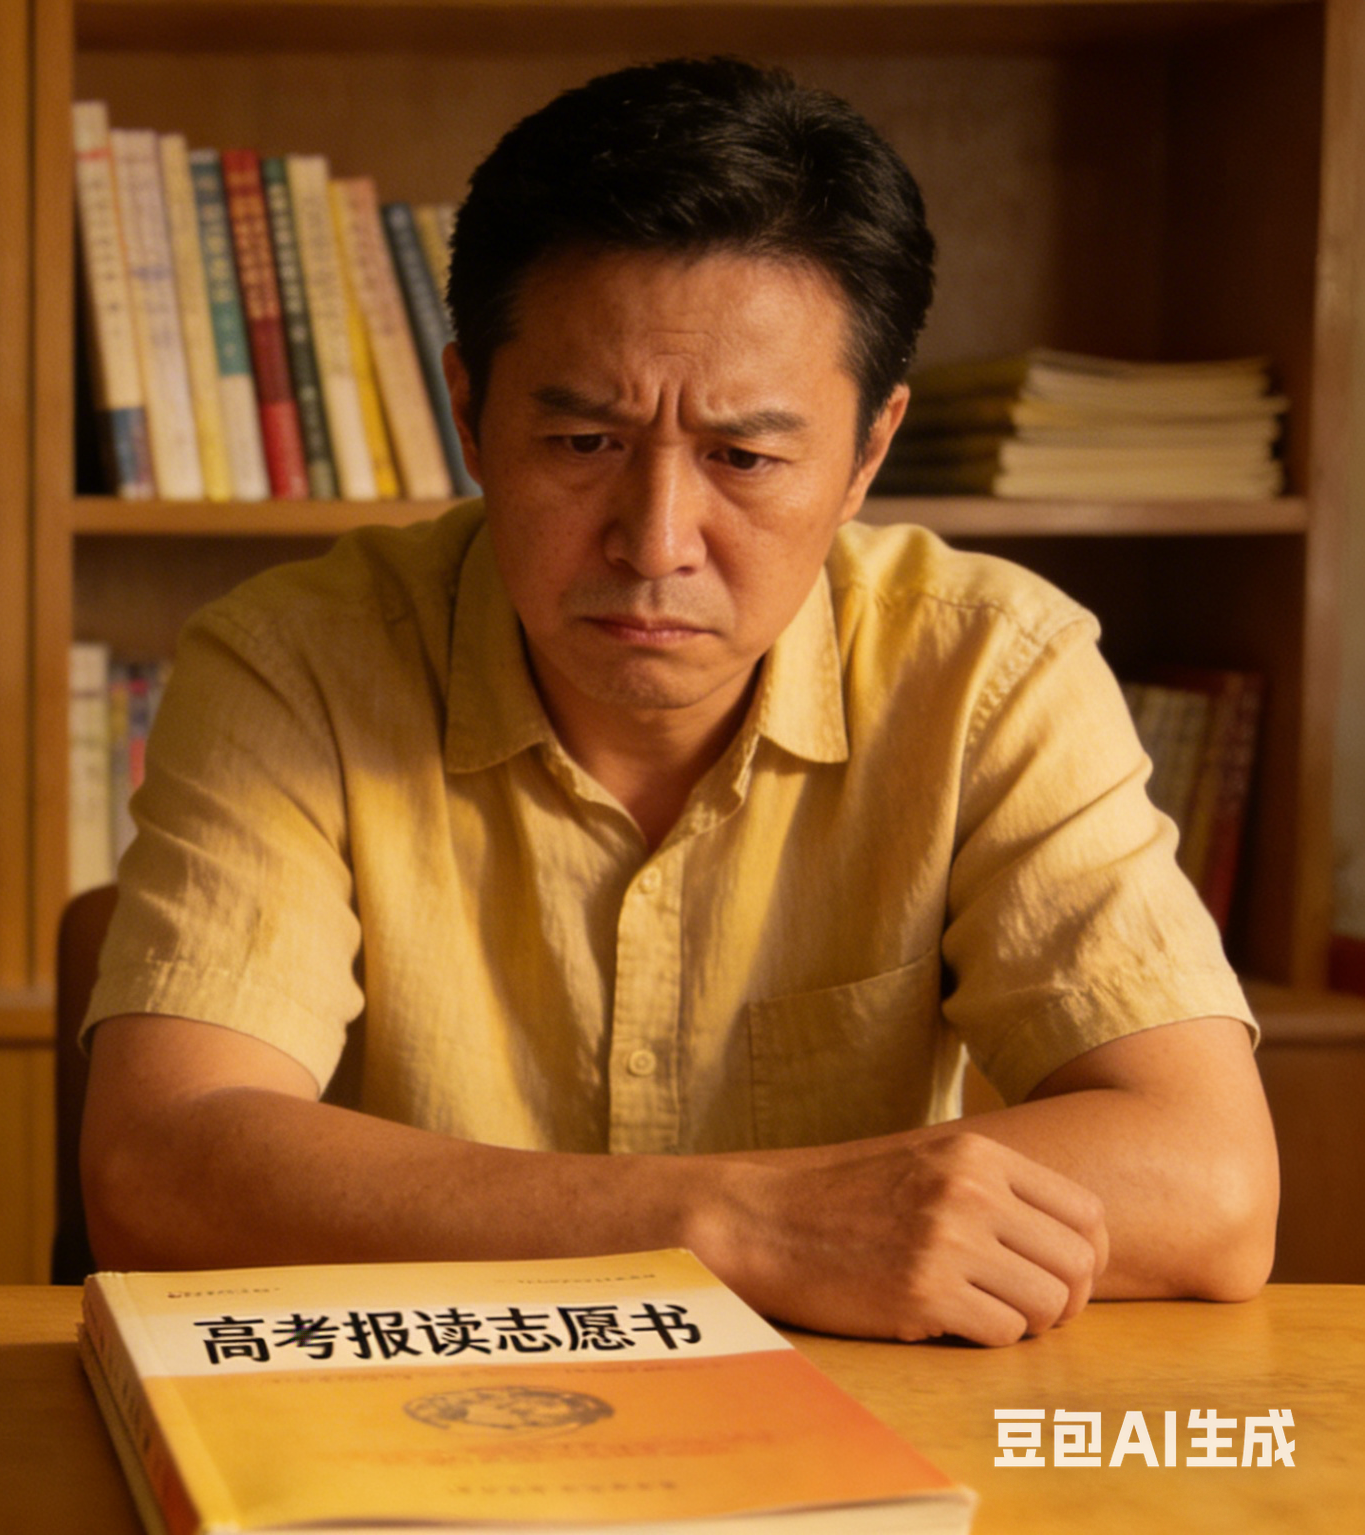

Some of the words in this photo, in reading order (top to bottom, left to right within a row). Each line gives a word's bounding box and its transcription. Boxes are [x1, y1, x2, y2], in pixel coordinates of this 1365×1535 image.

[193, 1302, 702, 1365] 高考报读志愿书
